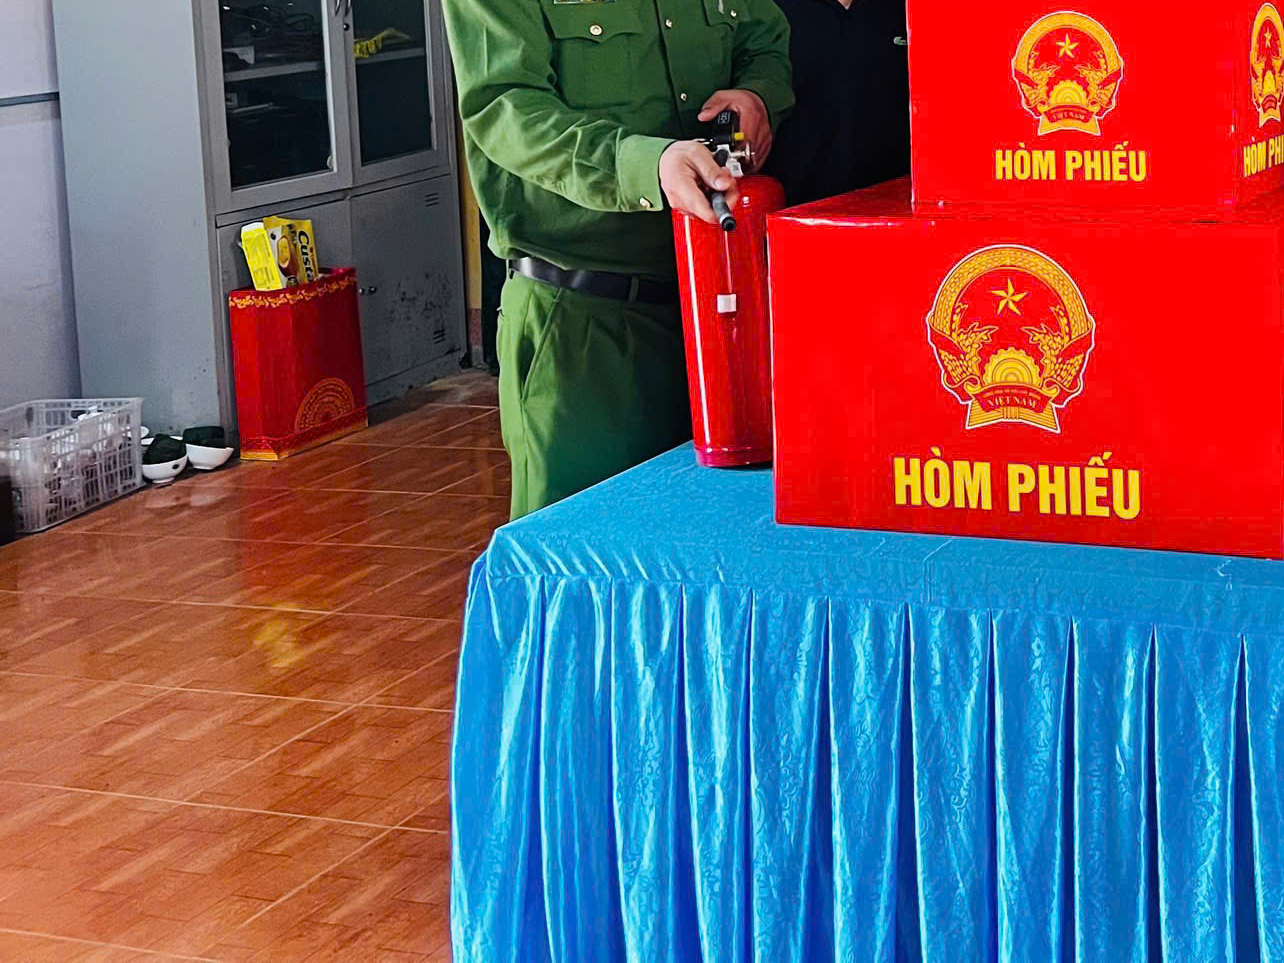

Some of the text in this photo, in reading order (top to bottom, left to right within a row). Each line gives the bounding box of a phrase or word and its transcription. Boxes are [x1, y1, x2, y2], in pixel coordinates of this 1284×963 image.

[995, 140, 1147, 182] HÒM PHIẾU
[1243, 135, 1267, 178] HÒM
[894, 446, 1140, 520] HÒM PHIẾU
